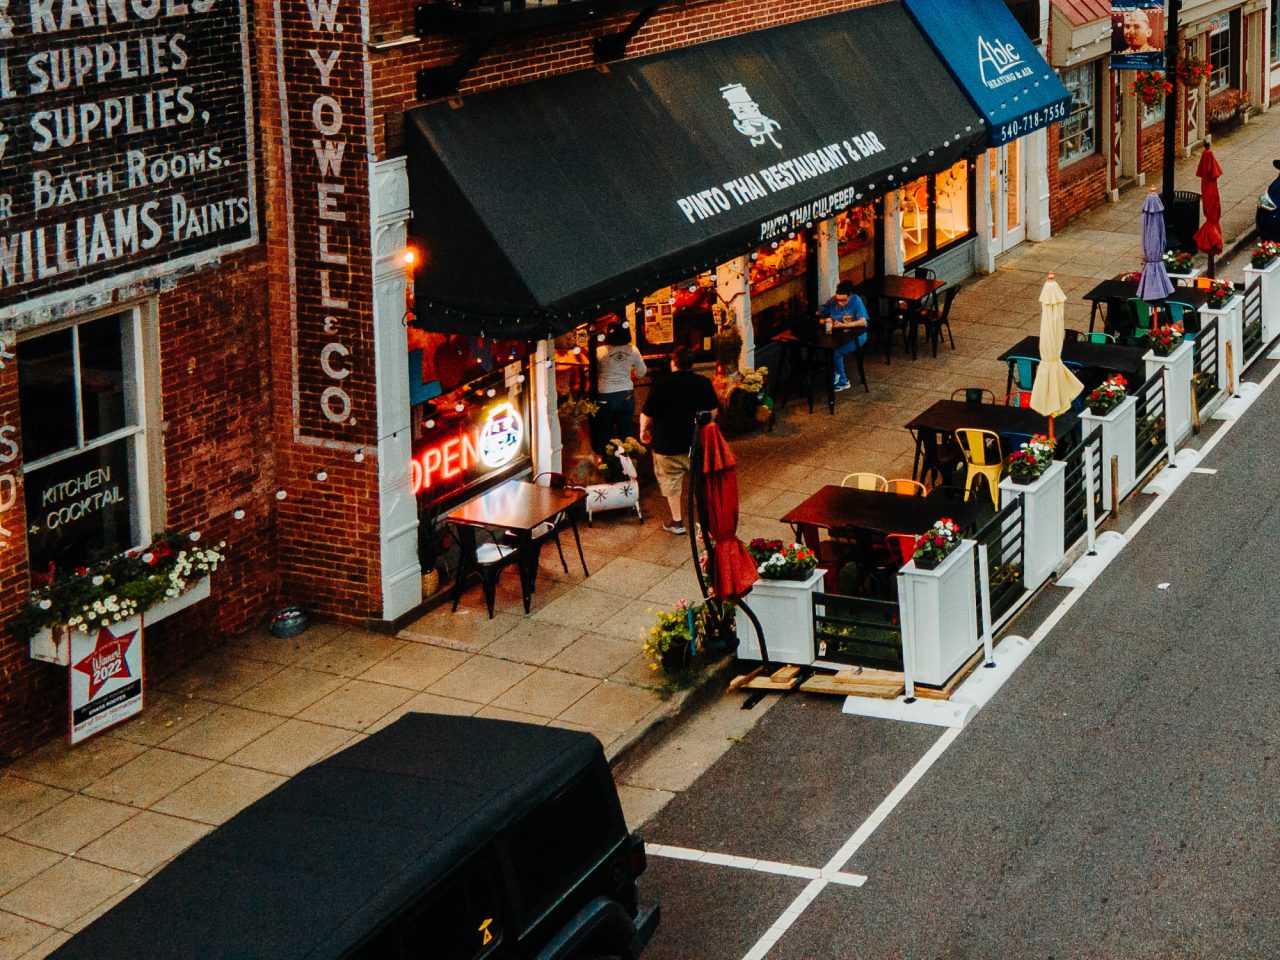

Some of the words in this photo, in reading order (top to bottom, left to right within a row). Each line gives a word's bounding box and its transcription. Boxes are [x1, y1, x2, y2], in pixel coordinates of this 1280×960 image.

[27, 33, 188, 95] SUPPLIES
[978, 35, 1026, 88] Able
[987, 72, 1017, 90] HEATING
[1021, 66, 1034, 77] AIR
[31, 86, 210, 152] SUPPLIES,
[1001, 102, 1065, 142] 540-718-7556
[32, 169, 114, 215] BATH
[127, 146, 231, 189] ROOMS.
[308, 48, 350, 309] YOWELL
[677, 186, 731, 224] PINTO
[723, 173, 768, 206] THAI
[759, 143, 849, 193] RESTAURANT
[843, 140, 861, 162] &
[852, 130, 886, 157] BAR
[172, 194, 249, 241] PAINTS
[760, 214, 788, 241] PINTO
[789, 207, 811, 227] THAI
[320, 342, 356, 426] CO.
[42, 465, 111, 508] KITCHEN
[47, 486, 125, 530] COCKTAIL
[93, 659, 122, 686] 2022
